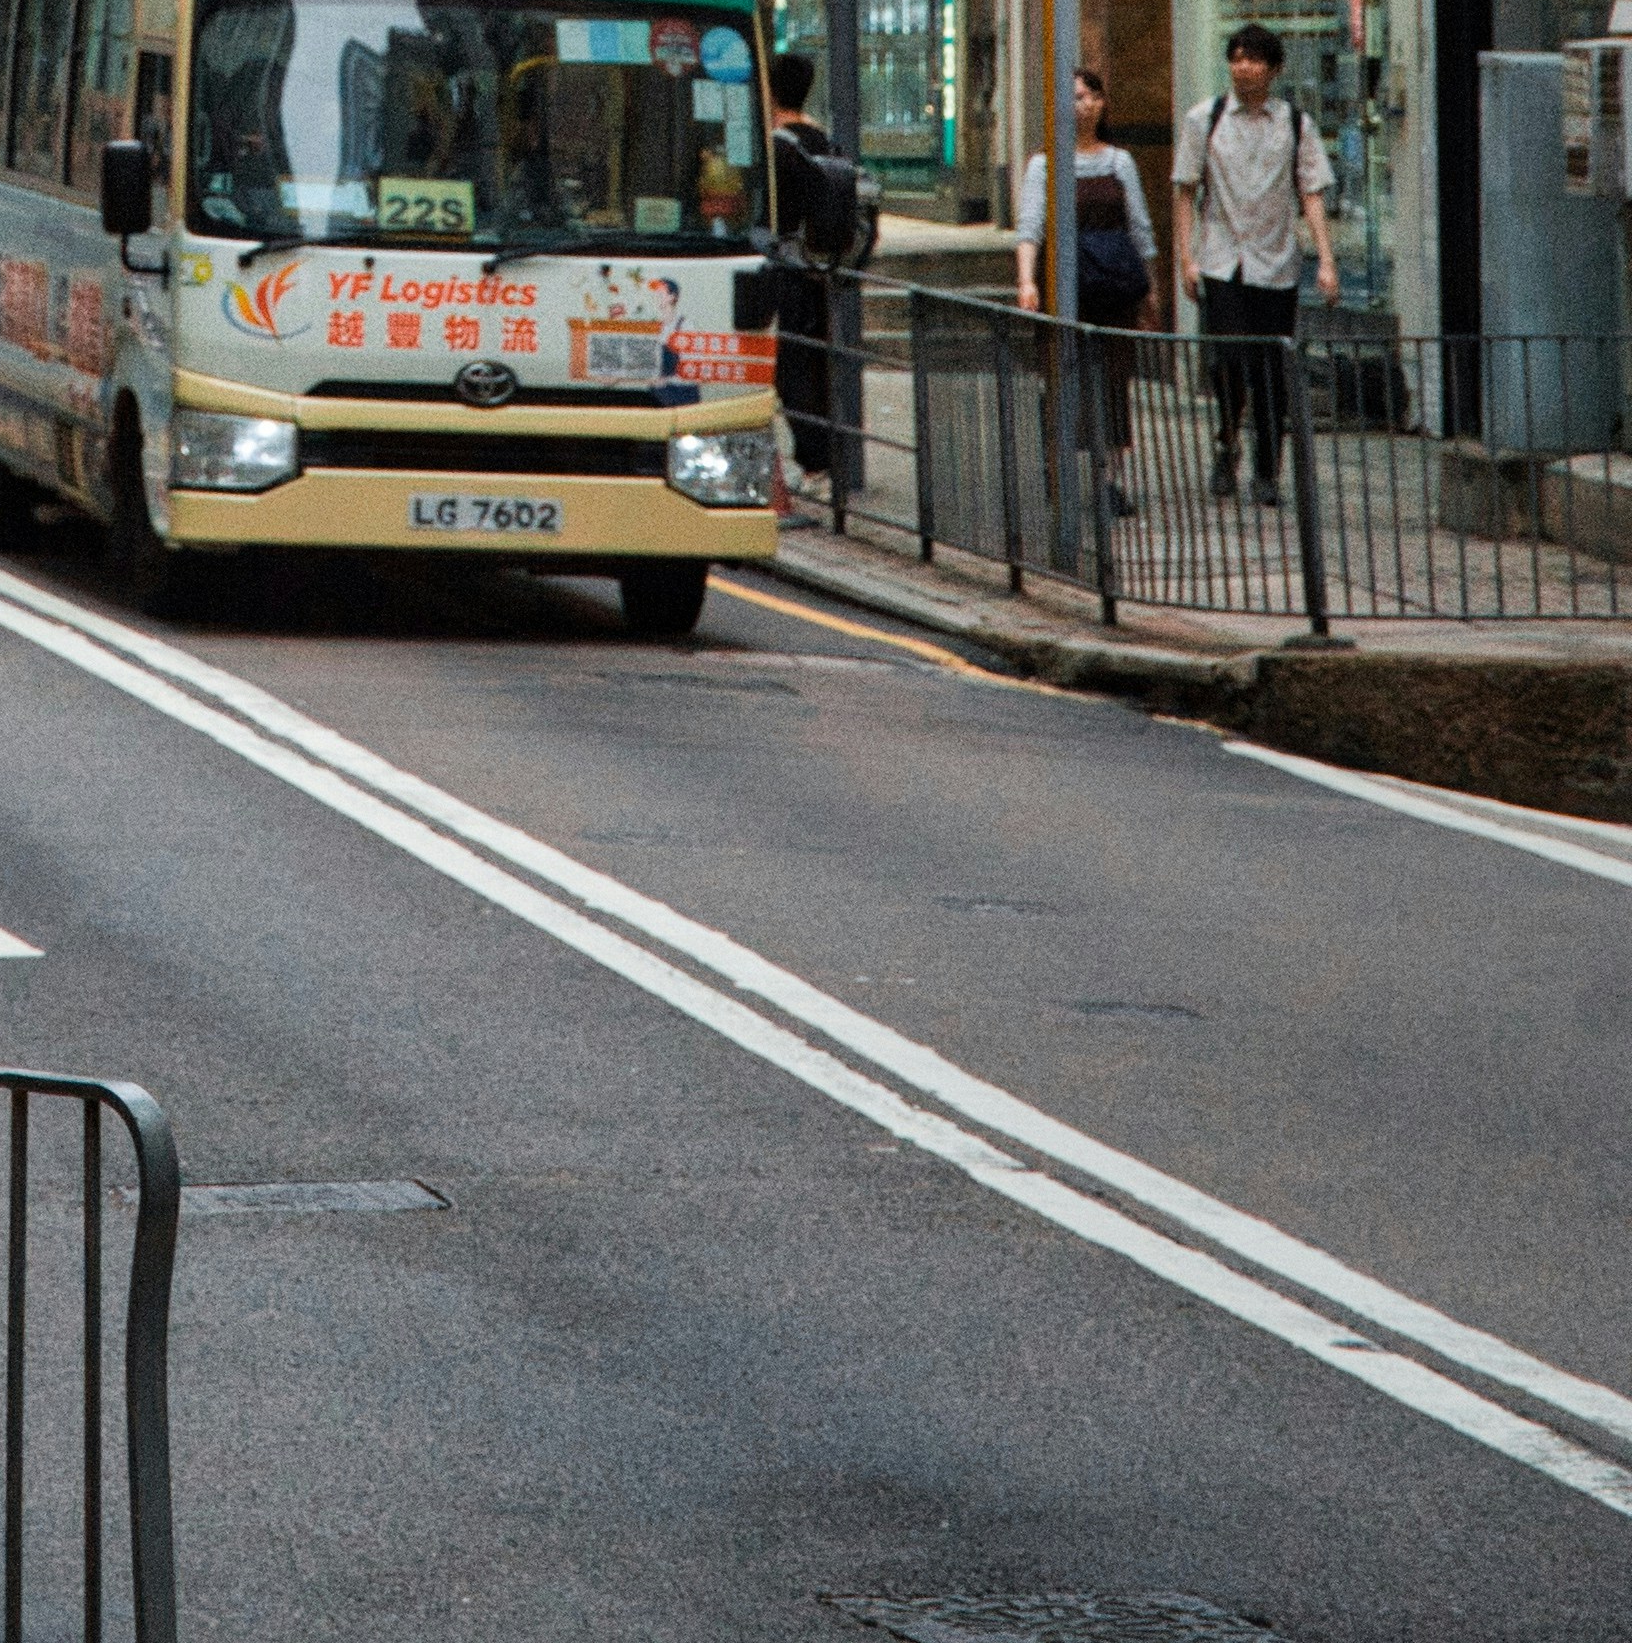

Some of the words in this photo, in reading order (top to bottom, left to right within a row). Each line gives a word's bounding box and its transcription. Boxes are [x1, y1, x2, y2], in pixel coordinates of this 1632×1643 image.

[387, 195, 464, 230] 22S
[328, 271, 374, 301] YF
[379, 273, 538, 310] Logistics
[326, 311, 539, 354] 越豐物流
[414, 498, 458, 527] LG
[472, 499, 558, 531] 7602
